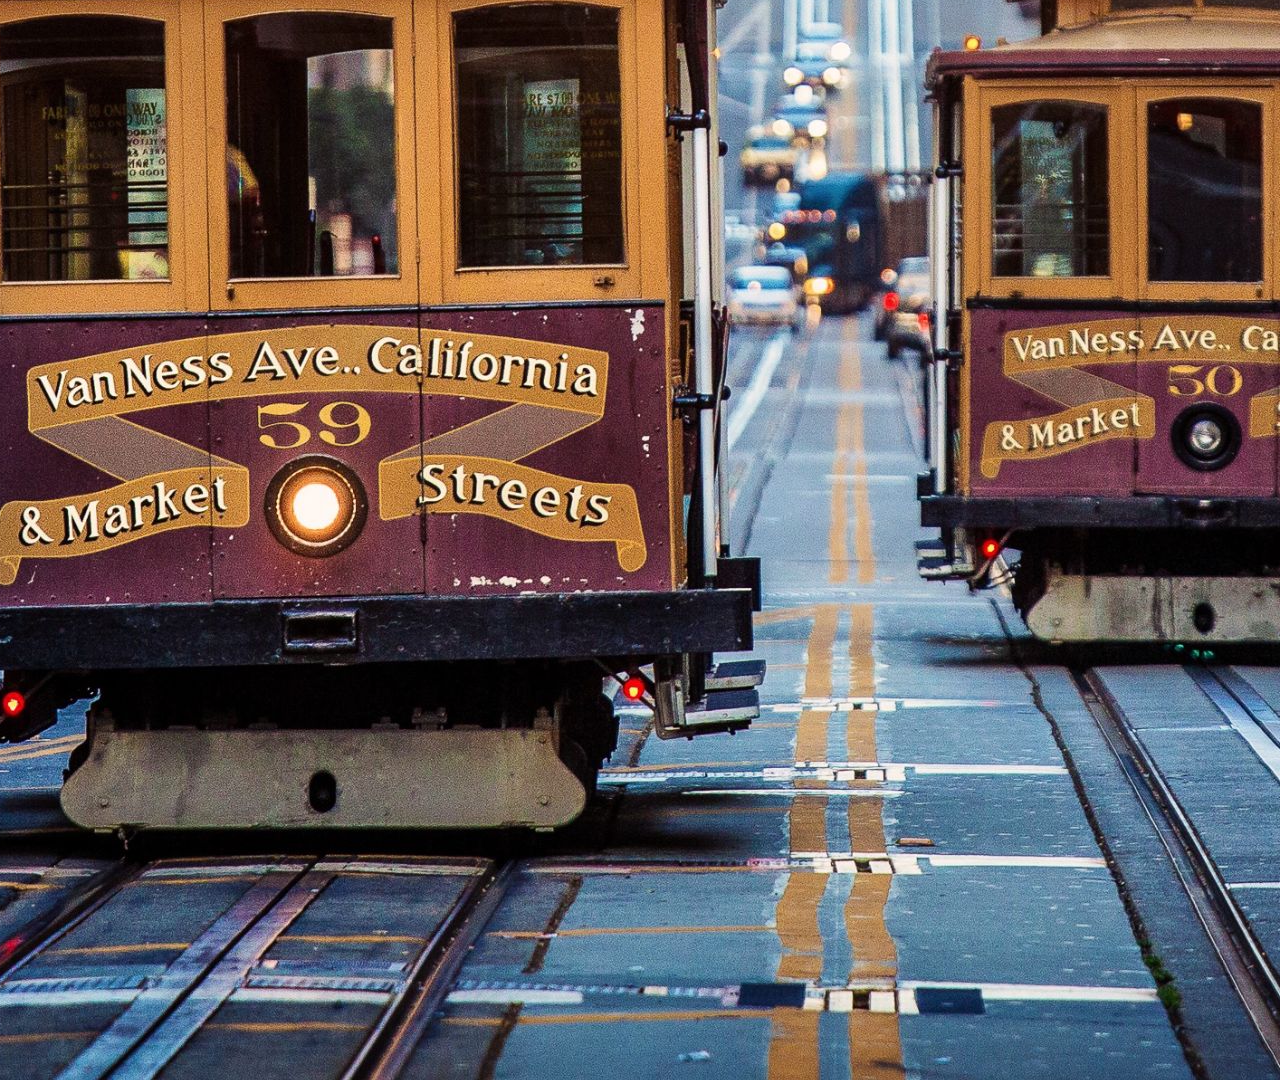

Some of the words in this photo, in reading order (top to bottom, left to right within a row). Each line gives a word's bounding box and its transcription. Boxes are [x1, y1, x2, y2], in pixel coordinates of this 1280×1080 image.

[131, 101, 158, 116] WAY
[368, 335, 598, 395] California
[1167, 363, 1244, 397] 50
[257, 400, 372, 450] 59
[1000, 424, 1023, 451] &
[1029, 403, 1141, 449] Market
[20, 506, 53, 545] &
[63, 476, 228, 543] Market
[418, 463, 612, 525] Streets
